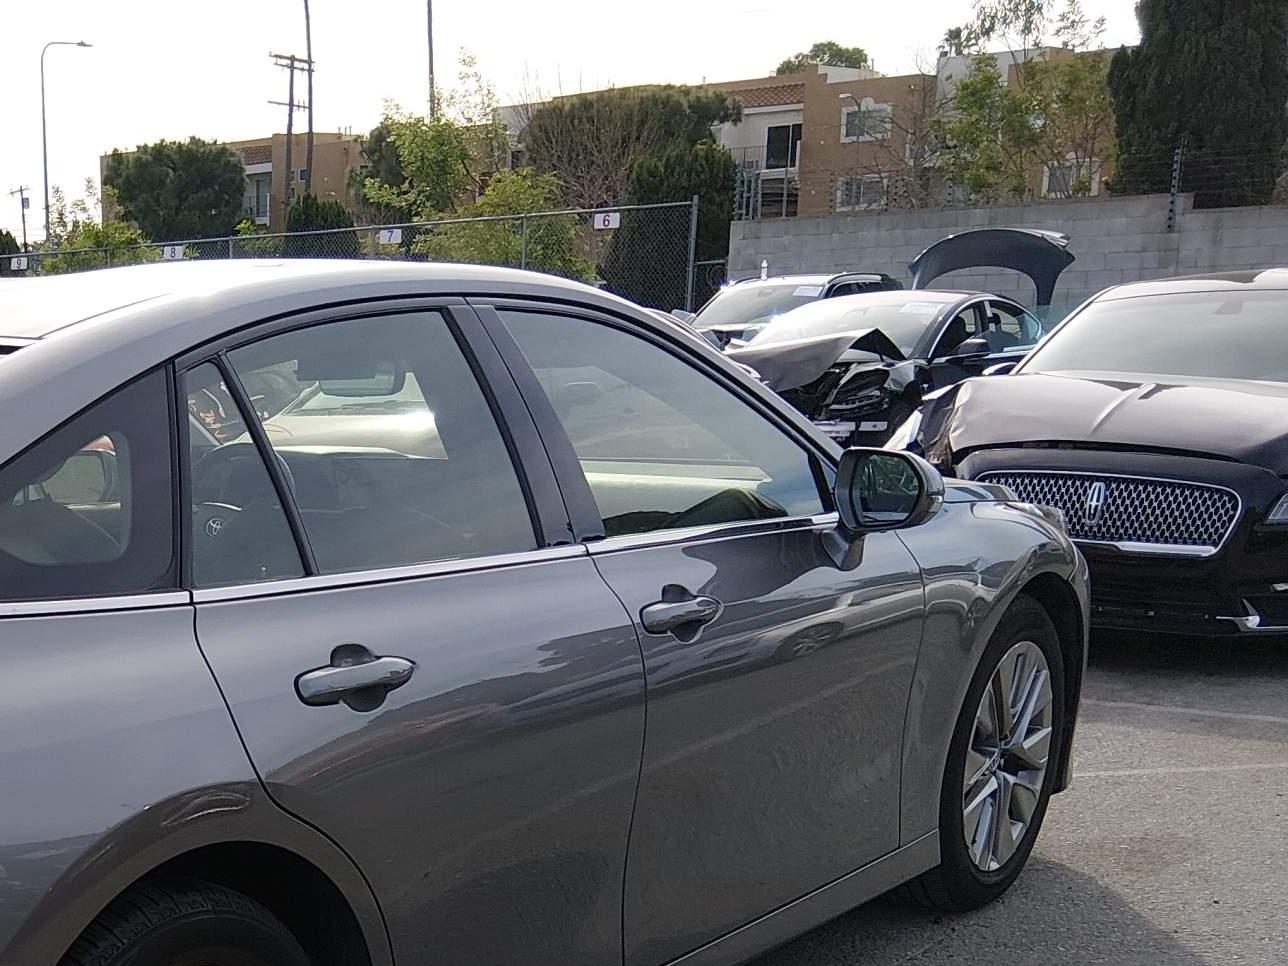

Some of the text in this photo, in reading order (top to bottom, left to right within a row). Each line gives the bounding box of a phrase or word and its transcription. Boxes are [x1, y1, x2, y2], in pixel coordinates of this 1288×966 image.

[602, 214, 611, 228] 6
[386, 230, 395, 243] 7
[169, 247, 176, 259] 8
